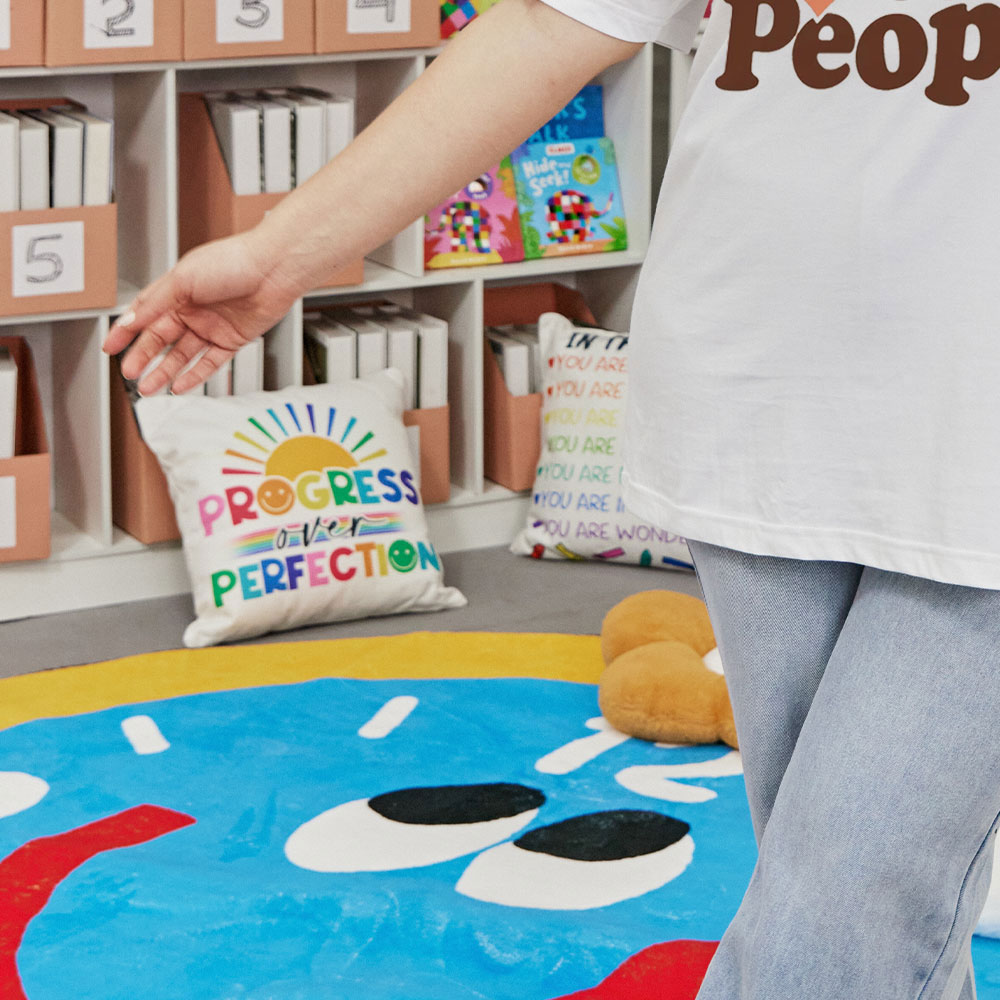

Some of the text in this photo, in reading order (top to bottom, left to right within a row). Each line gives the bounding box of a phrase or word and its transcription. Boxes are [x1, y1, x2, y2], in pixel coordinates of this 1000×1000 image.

[528, 124, 571, 144] ALK
[26, 233, 64, 284] 5
[566, 332, 598, 350] IN
[557, 354, 628, 373] YOU ARE
[557, 380, 626, 399] YOU ARE
[585, 408, 620, 427] ARE
[582, 436, 617, 455] ARE
[579, 465, 613, 483] ARE
[541, 491, 572, 510] YOU
[577, 493, 611, 512] ARE
[276, 515, 388, 549] over
[576, 521, 610, 540] ARE
